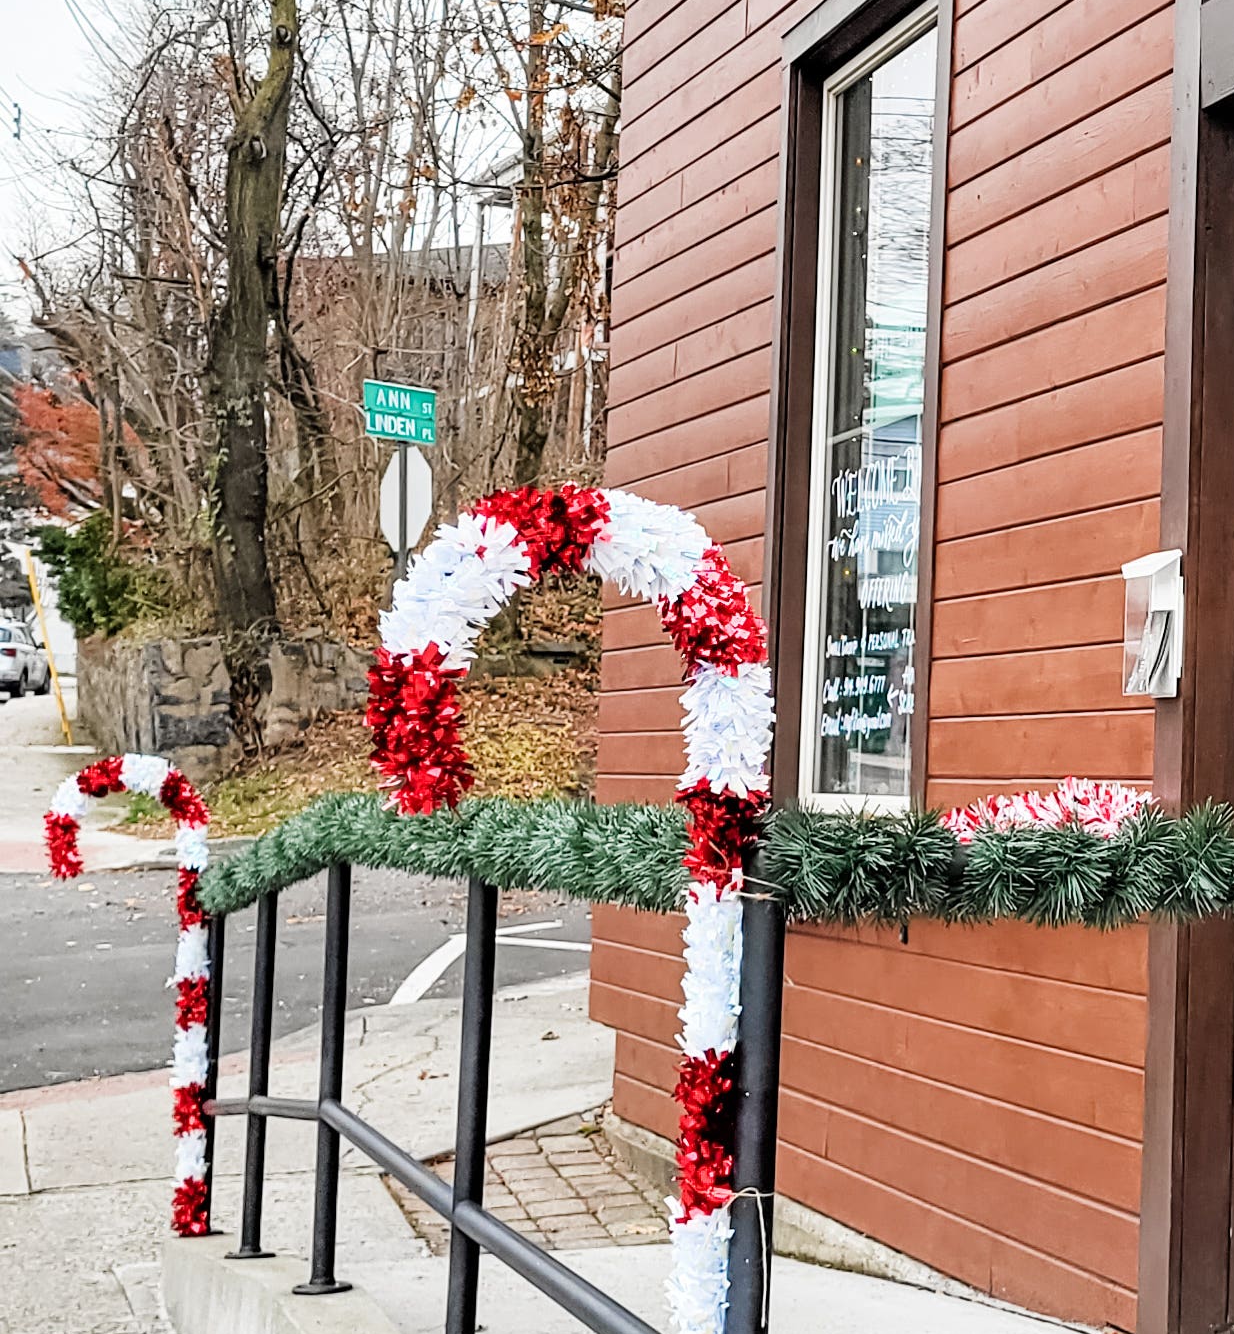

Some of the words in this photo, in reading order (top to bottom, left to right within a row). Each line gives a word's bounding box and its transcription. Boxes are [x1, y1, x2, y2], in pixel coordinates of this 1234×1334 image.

[376, 389, 411, 410] ANN
[422, 402, 433, 415] ST
[366, 411, 415, 437] LINDEN
[422, 428, 433, 441] PL
[832, 455, 900, 518] WELCOME
[860, 571, 909, 612] OFFERING
